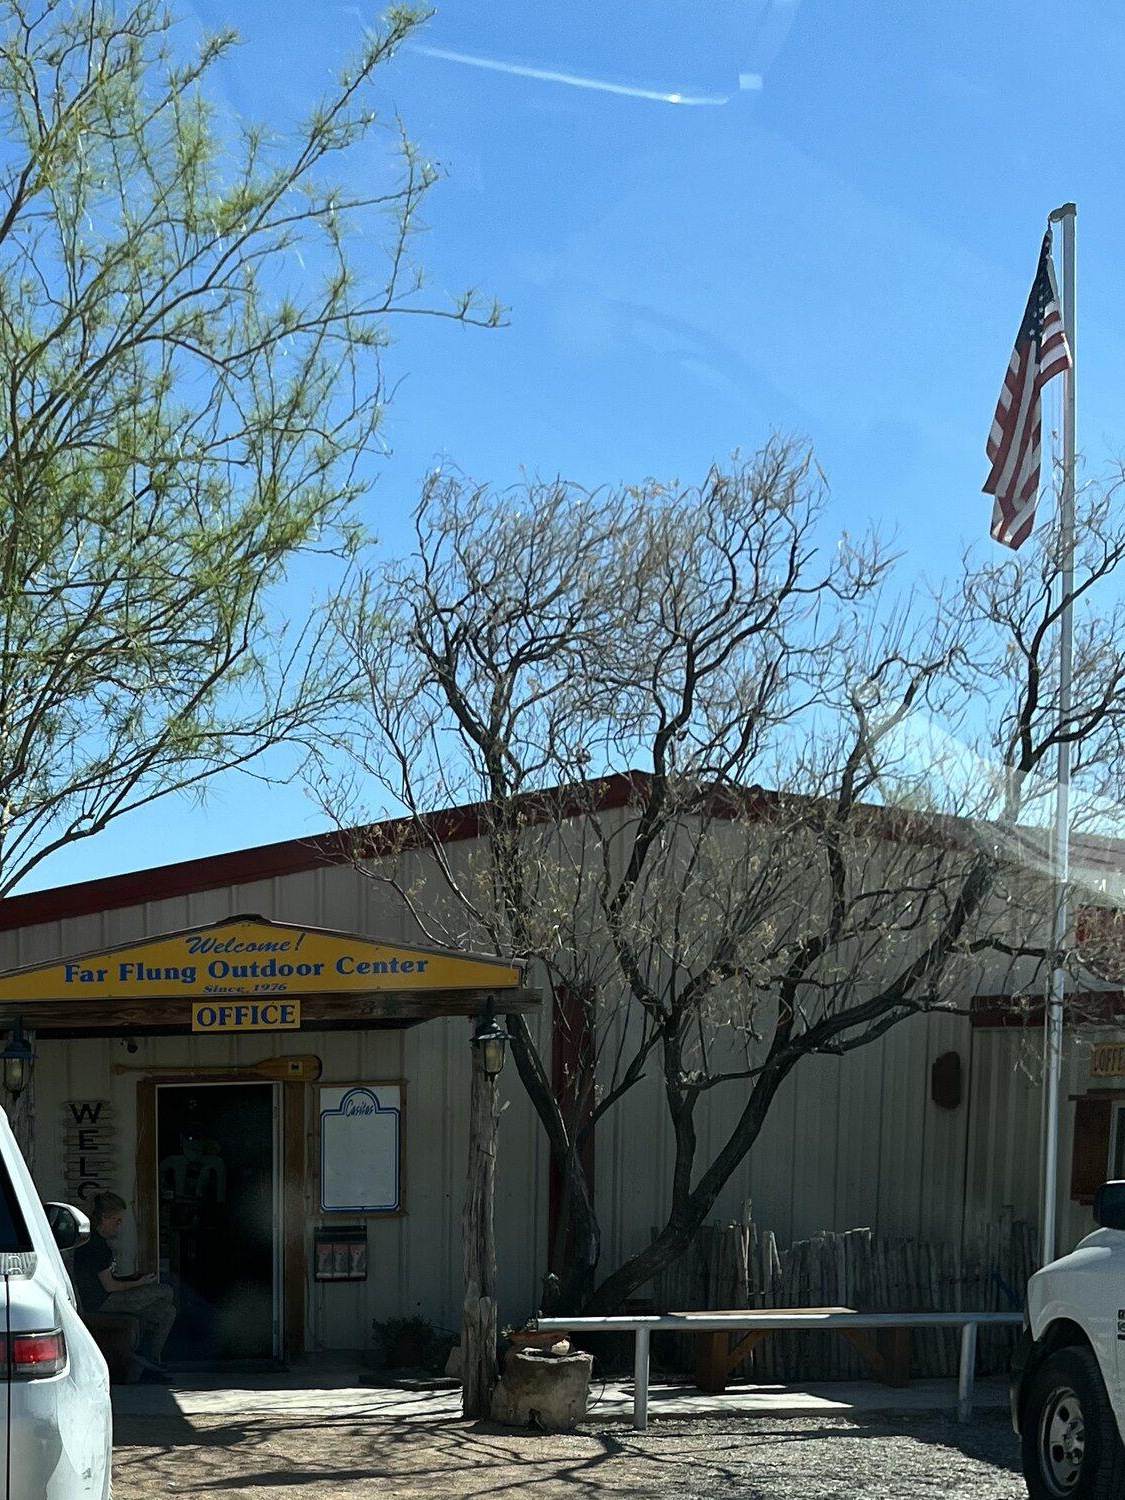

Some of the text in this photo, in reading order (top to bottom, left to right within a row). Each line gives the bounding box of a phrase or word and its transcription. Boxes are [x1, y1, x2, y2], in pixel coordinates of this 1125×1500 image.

[185, 932, 306, 954] Welcome!
[64, 955, 429, 984] Far Flung Outdoor Center
[253, 983, 287, 992] 1976
[196, 1004, 296, 1028] OFFICE
